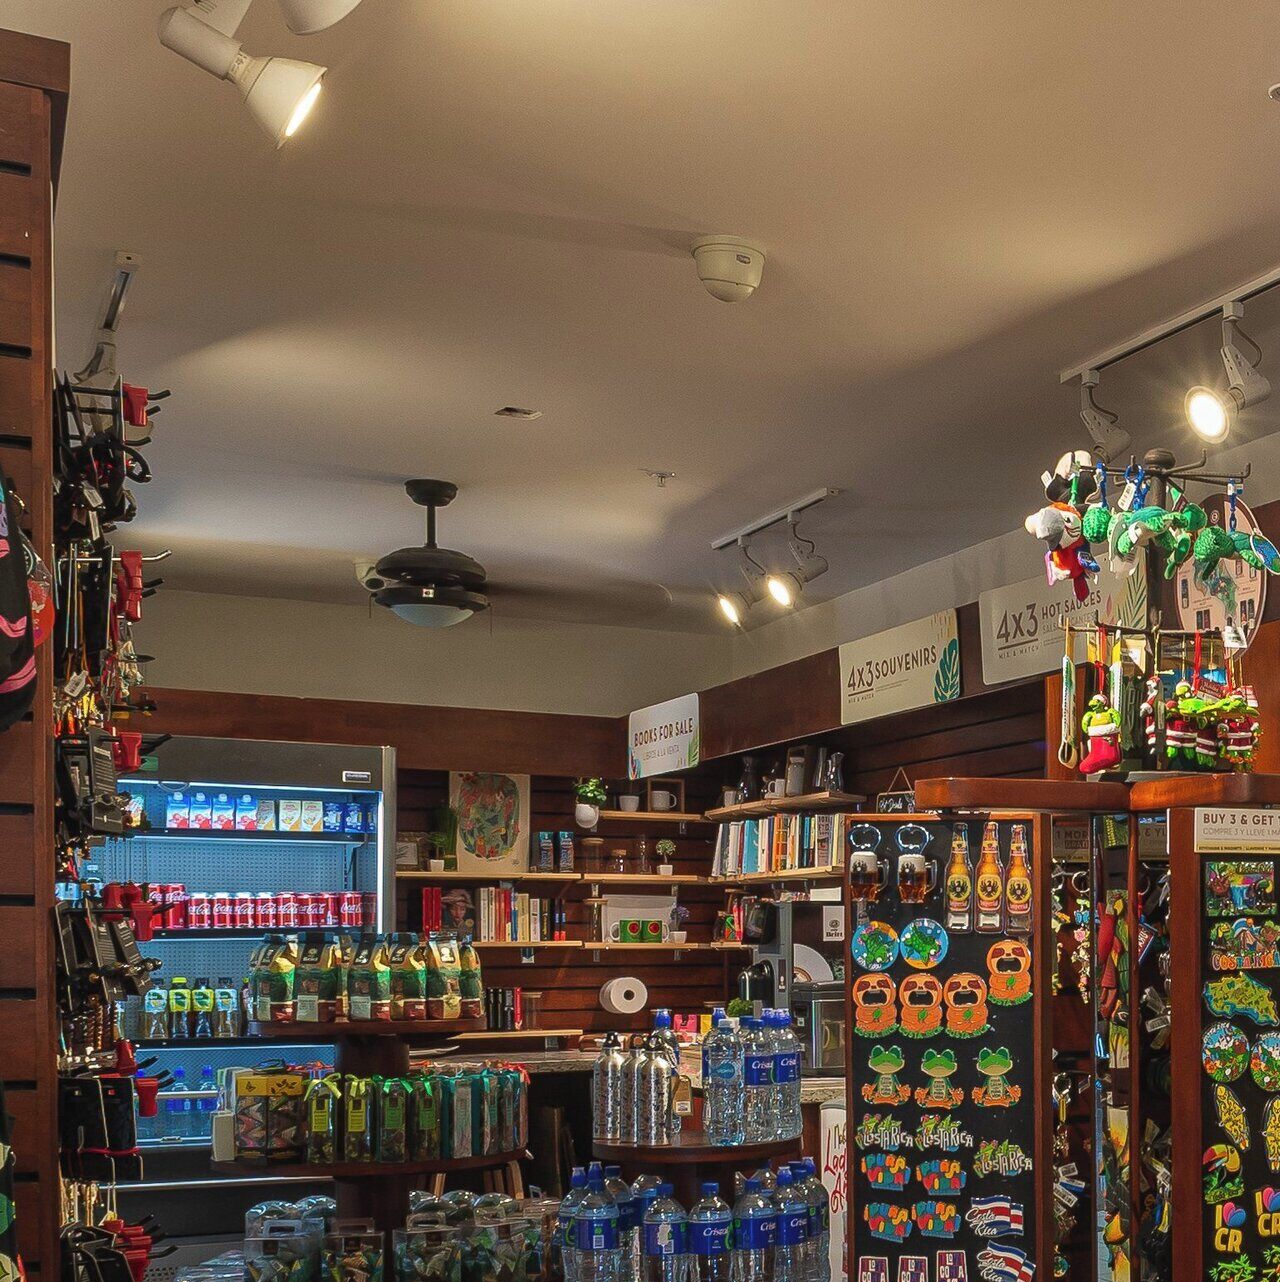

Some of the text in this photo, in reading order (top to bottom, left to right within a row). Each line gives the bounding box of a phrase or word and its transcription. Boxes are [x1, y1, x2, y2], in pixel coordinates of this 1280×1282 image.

[996, 603, 1038, 643] 4x3
[1042, 602, 1061, 619] HOT
[848, 645, 937, 691] 4x3 SOUVENIRS
[634, 718, 693, 747] BOOKS FOR SALE
[1203, 814, 1226, 825] BUY
[1230, 814, 1237, 824] 3
[1240, 815, 1248, 825] &
[1252, 815, 1274, 826] GET
